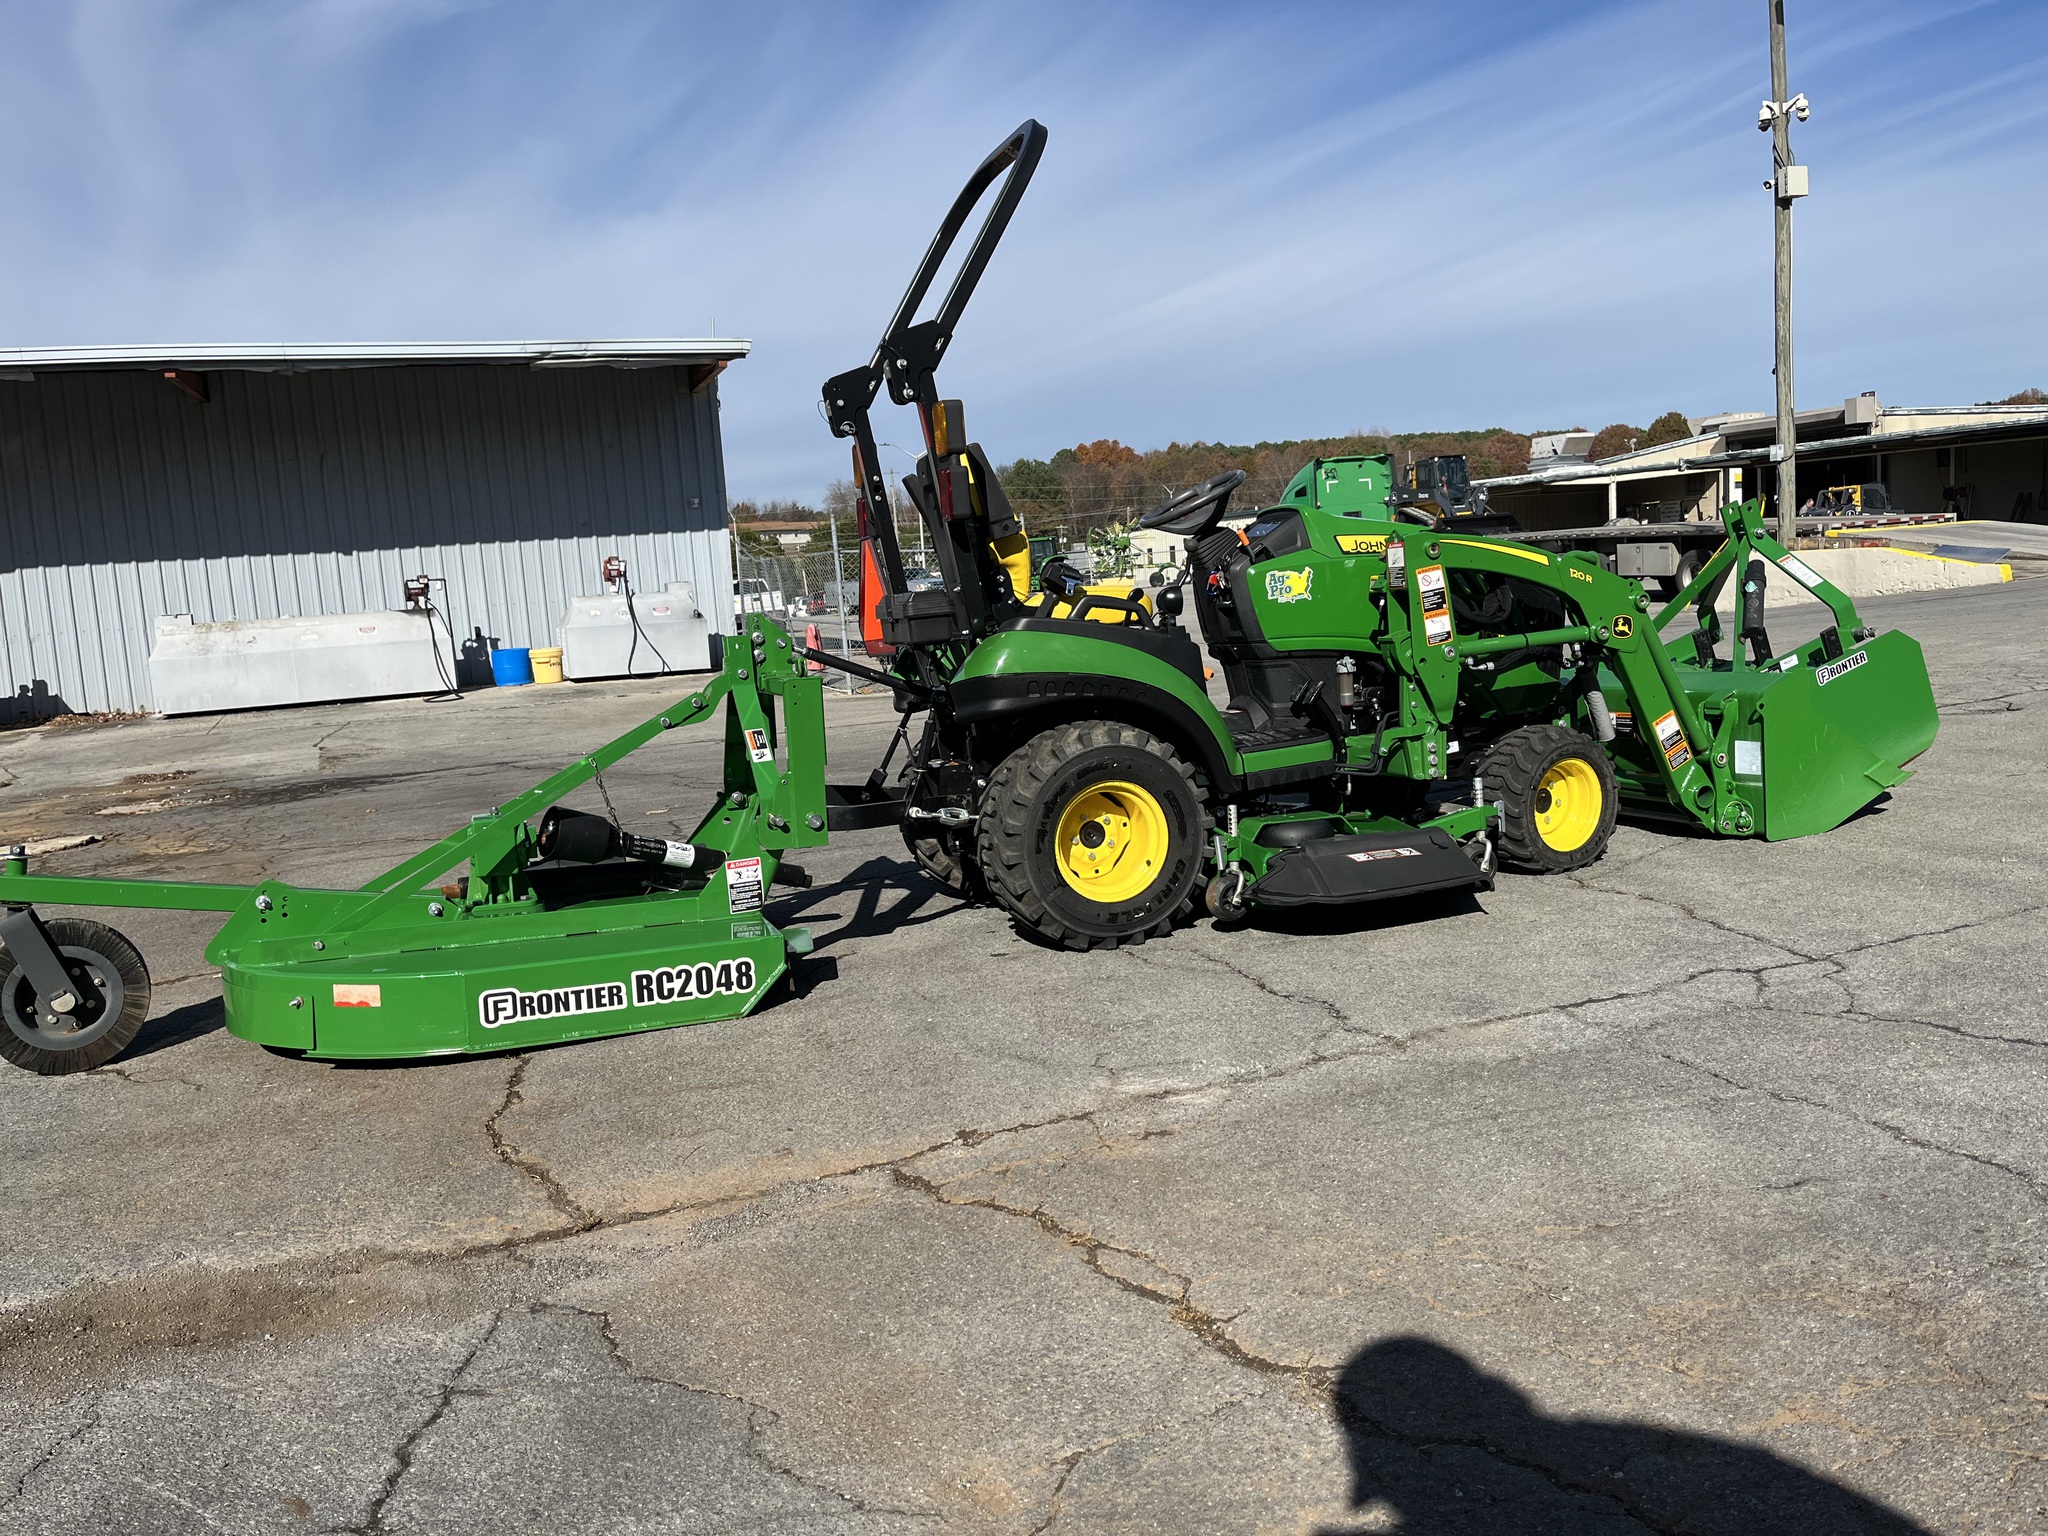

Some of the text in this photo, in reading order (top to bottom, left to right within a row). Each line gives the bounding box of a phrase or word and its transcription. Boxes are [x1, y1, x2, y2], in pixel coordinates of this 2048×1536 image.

[1351, 540, 1387, 551] JOHN
[1268, 573, 1289, 586] Ag-
[1269, 585, 1292, 598] Pro
[1817, 651, 1867, 685] FRONTIER
[735, 859, 757, 867] DANGER
[483, 959, 754, 1025] FRONTIER RC2048
